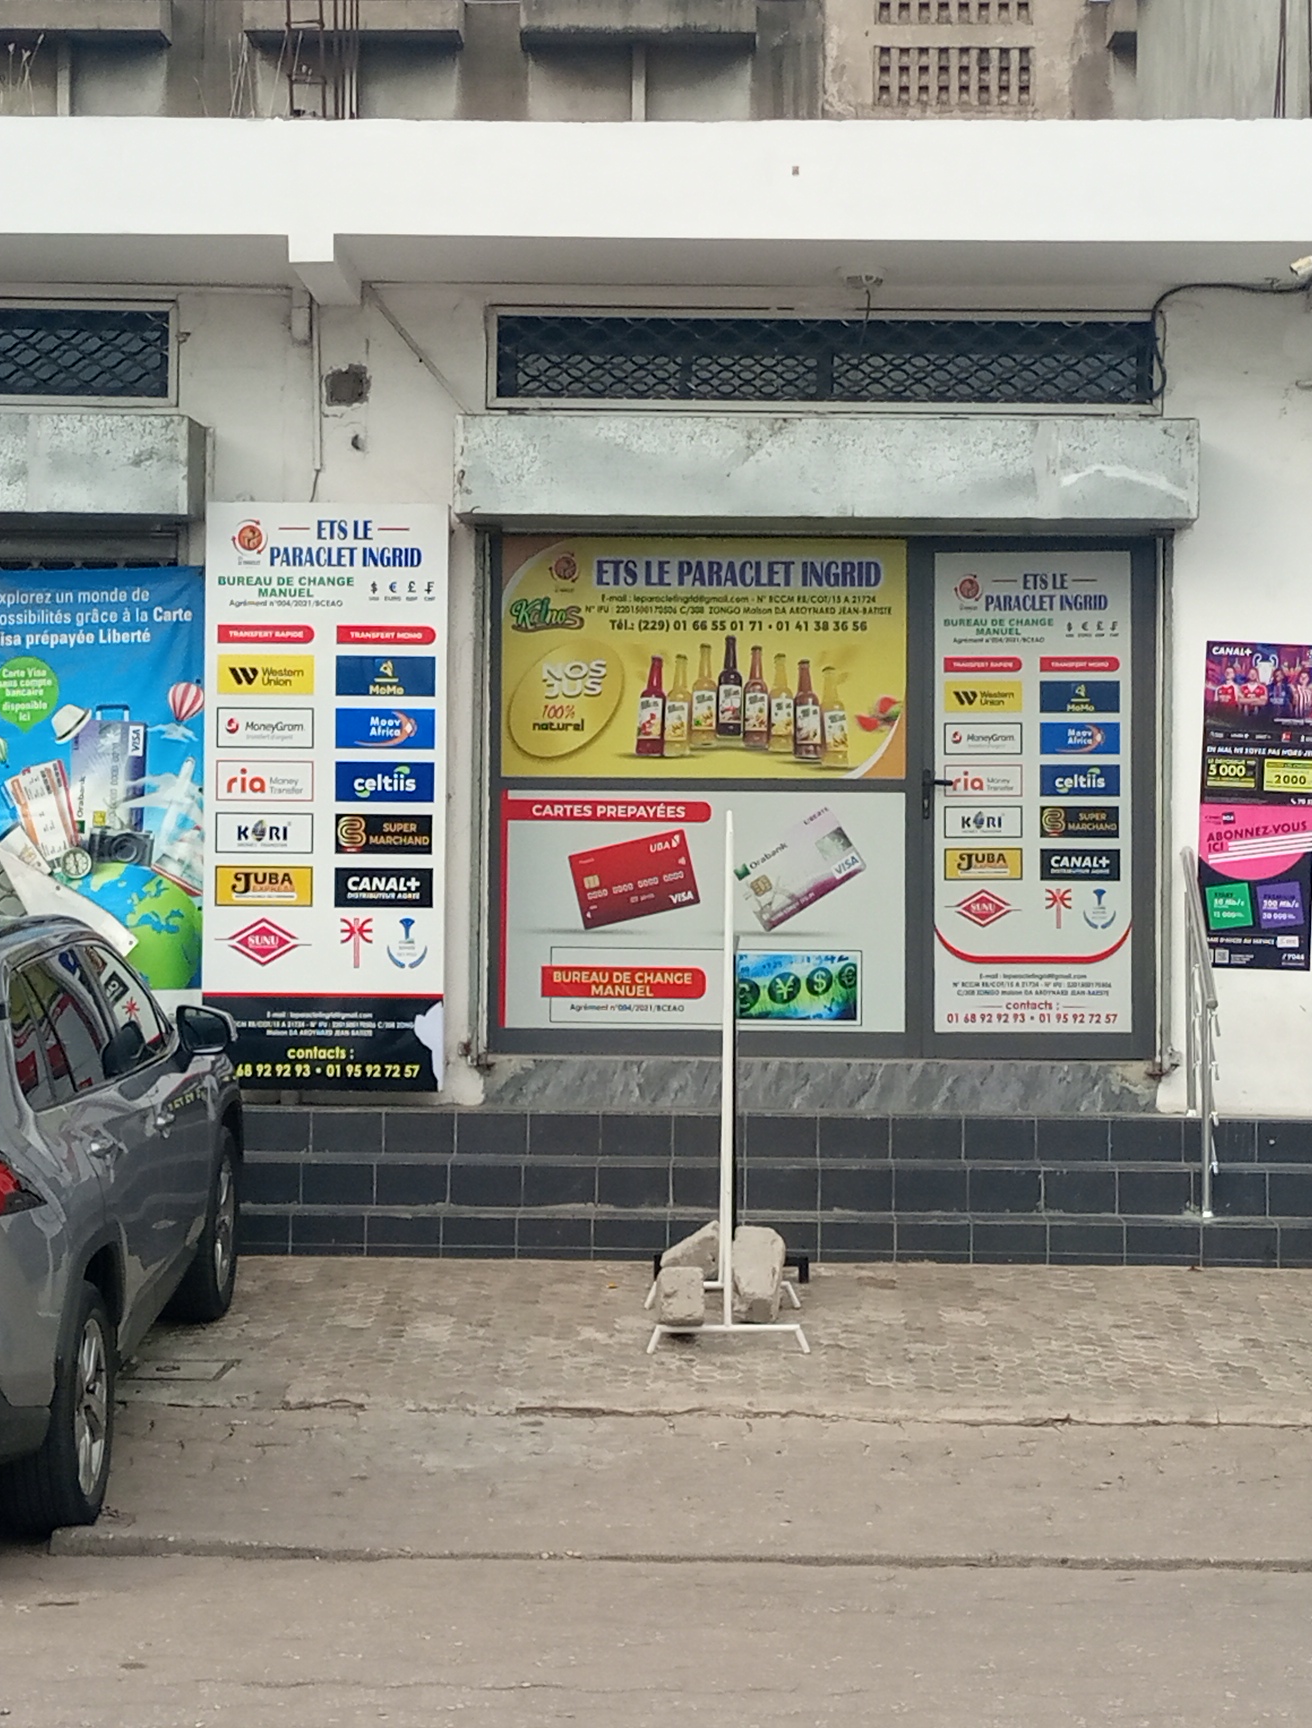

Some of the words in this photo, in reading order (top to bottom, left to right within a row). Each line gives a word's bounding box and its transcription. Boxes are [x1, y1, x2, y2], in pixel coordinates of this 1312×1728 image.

[317, 520, 348, 540] ETS
[354, 520, 373, 540] LE
[270, 547, 357, 567] PARACLET
[362, 547, 422, 567] INGRID
[597, 560, 637, 586] ETS
[645, 560, 671, 586] LE
[678, 560, 794, 587] PARACLET
[802, 561, 881, 587] INGRID
[218, 576, 272, 586] BUREAU
[277, 577, 294, 586] DE
[299, 577, 354, 586] CHANGE
[1023, 574, 1049, 590] ETS
[1052, 574, 1068, 589] LE
[56, 592, 73, 603] un
[78, 588, 127, 603] monde
[132, 587, 149, 601] de
[258, 588, 314, 597] MANUEL
[985, 595, 1056, 611] PARACLET
[1060, 595, 1108, 611] INGRID
[76, 608, 118, 626] grâce
[122, 609, 130, 621] à
[136, 608, 148, 621] la
[153, 606, 192, 622] Carte
[943, 618, 987, 626] BUREAU
[992, 618, 1006, 626] DE
[1009, 618, 1054, 626] CHANGE
[638, 619, 669, 632] (229)
[674, 620, 687, 630] 01
[693, 620, 707, 631] 66
[711, 620, 726, 631] 55
[731, 620, 743, 631] 01
[750, 621, 762, 631] 71
[776, 621, 789, 631] 01
[795, 621, 808, 631] 41
[814, 621, 829, 631] 38
[833, 621, 848, 631] 36
[852, 621, 867, 631] 56
[26, 631, 94, 648] prépayée
[99, 628, 151, 644] Liberté
[1212, 647, 1252, 656] CANAL+
[3, 669, 25, 678] Carte
[27, 667, 46, 677] Visa
[262, 667, 304, 676] Western
[542, 659, 606, 681] NOS
[20, 679, 52, 687] compte
[262, 677, 292, 686] Union
[6, 688, 43, 696] bancaire
[369, 684, 404, 695] MoMo
[543, 678, 602, 699] JUS
[2, 700, 47, 713] disponible
[980, 698, 1005, 706] Union
[1067, 704, 1095, 712] MoMo
[543, 704, 575, 719] 100%
[245, 721, 304, 733] MoneyGram
[370, 716, 401, 727] Moov
[533, 719, 584, 731] naturel
[370, 726, 401, 737] Africa
[1067, 729, 1092, 737] Moov
[132, 729, 140, 752] VISA
[967, 733, 1015, 743] MoneyGram
[1067, 737, 1092, 745] Africa
[1209, 765, 1216, 775] 5
[1219, 765, 1246, 776] 000
[227, 768, 265, 793] ria
[270, 777, 299, 786] Money
[353, 774, 416, 792] celtiis
[952, 771, 984, 791] ria
[1055, 774, 1105, 788] celtiis
[77, 776, 86, 817] Orabank
[532, 805, 592, 817] CARTES
[597, 803, 686, 818] PREPAYÉES
[1079, 813, 1107, 821] SUPER
[383, 823, 417, 833] SUPER
[1068, 822, 1117, 831] MARCHAND
[1207, 821, 1307, 842] ABONNEZ-VOUS
[370, 836, 429, 846] MARCHAND
[650, 841, 670, 852] UBA
[1209, 842, 1223, 852] ICI
[749, 842, 787, 870] Orabank
[957, 853, 1006, 871] JUBA
[1050, 855, 1110, 868] CANAL+
[834, 856, 859, 874] VISA
[232, 872, 293, 893] JUBA
[347, 877, 420, 892] CANAL+
[669, 891, 694, 904] VISA
[970, 903, 996, 913] SUNU
[248, 935, 279, 946] SUNU
[553, 971, 609, 983] BUREAU
[613, 972, 631, 983] DE
[635, 973, 692, 984] CHANGE
[591, 985, 654, 997] MANUEL
[1006, 1001, 1053, 1010] contacts
[947, 1014, 958, 1023] 01
[964, 1014, 976, 1023] 68
[980, 1014, 992, 1023] 92
[997, 1014, 1009, 1023] 92
[1013, 1014, 1025, 1023] 93
[1039, 1014, 1051, 1023] 01
[1056, 1014, 1068, 1023] 95
[1072, 1014, 1084, 1023] 92
[1089, 1014, 1101, 1023] 72
[1105, 1014, 1117, 1023] 57
[287, 1047, 346, 1059] contacts
[236, 1064, 252, 1077] 68
[256, 1065, 271, 1077] 92
[276, 1065, 291, 1077] 92
[295, 1065, 310, 1077] 93
[326, 1065, 340, 1077] 01
[346, 1065, 361, 1077] 95
[366, 1065, 381, 1077] 92
[385, 1065, 400, 1077] 72
[404, 1065, 419, 1078] 57
